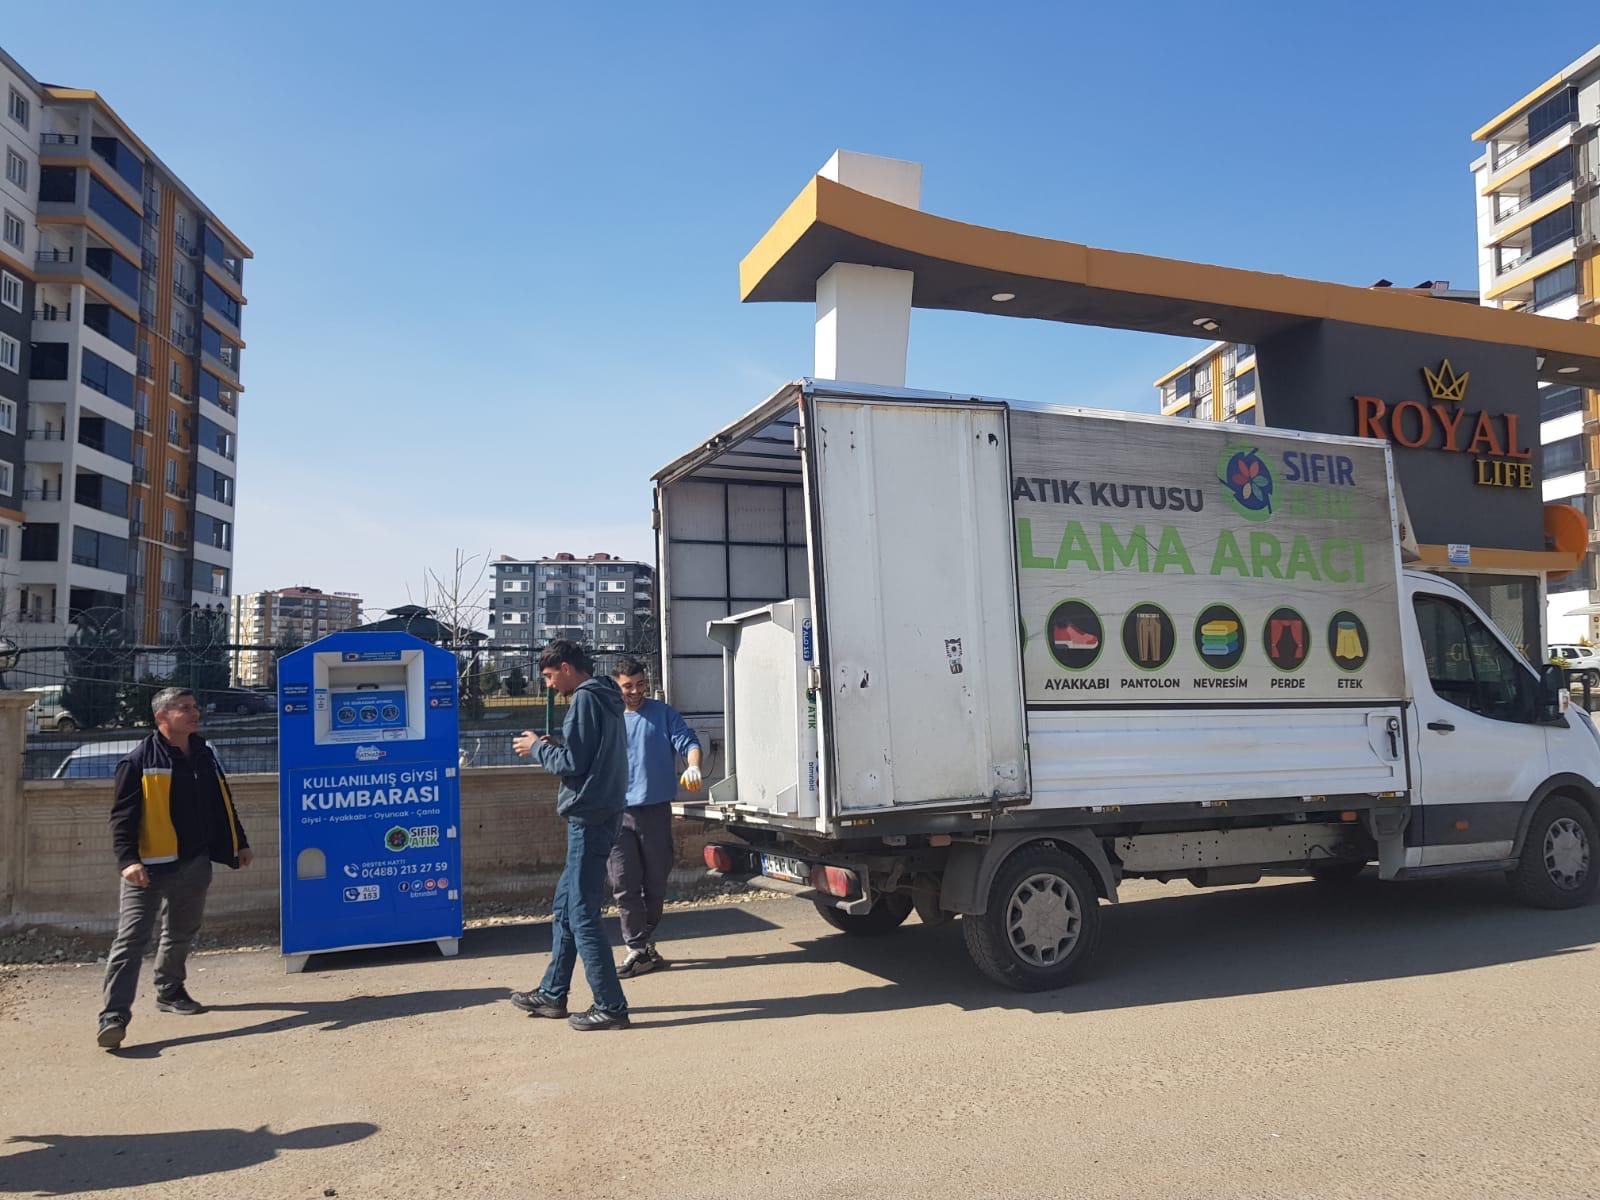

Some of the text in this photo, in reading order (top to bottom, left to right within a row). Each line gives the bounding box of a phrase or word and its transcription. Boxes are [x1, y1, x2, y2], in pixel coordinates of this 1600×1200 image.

[1353, 396, 1531, 459] ROYAL
[1283, 451, 1356, 486] SIFIR
[1476, 459, 1533, 488] LIFE
[1013, 476, 1204, 512] ATIK KUTUSU
[1210, 528, 1366, 583] ARACI
[1044, 678, 1110, 690] AYAKKABI
[1120, 678, 1181, 689] PANTOLON
[1193, 675, 1248, 689] NEVRESİM
[1270, 678, 1305, 689] PERDE
[1337, 678, 1363, 689] ETEK
[808, 706, 816, 729] ATIK
[303, 768, 437, 790] KULLANILMIŞ GİYSİ
[302, 786, 439, 811] KUMBARASI
[374, 811, 409, 820] Oyuncak
[416, 808, 440, 816] Çanta
[411, 827, 439, 837] SIFIR
[411, 835, 438, 847] ATIK
[400, 864, 417, 875] 213
[420, 863, 432, 873] 27
[435, 862, 447, 871] 59
